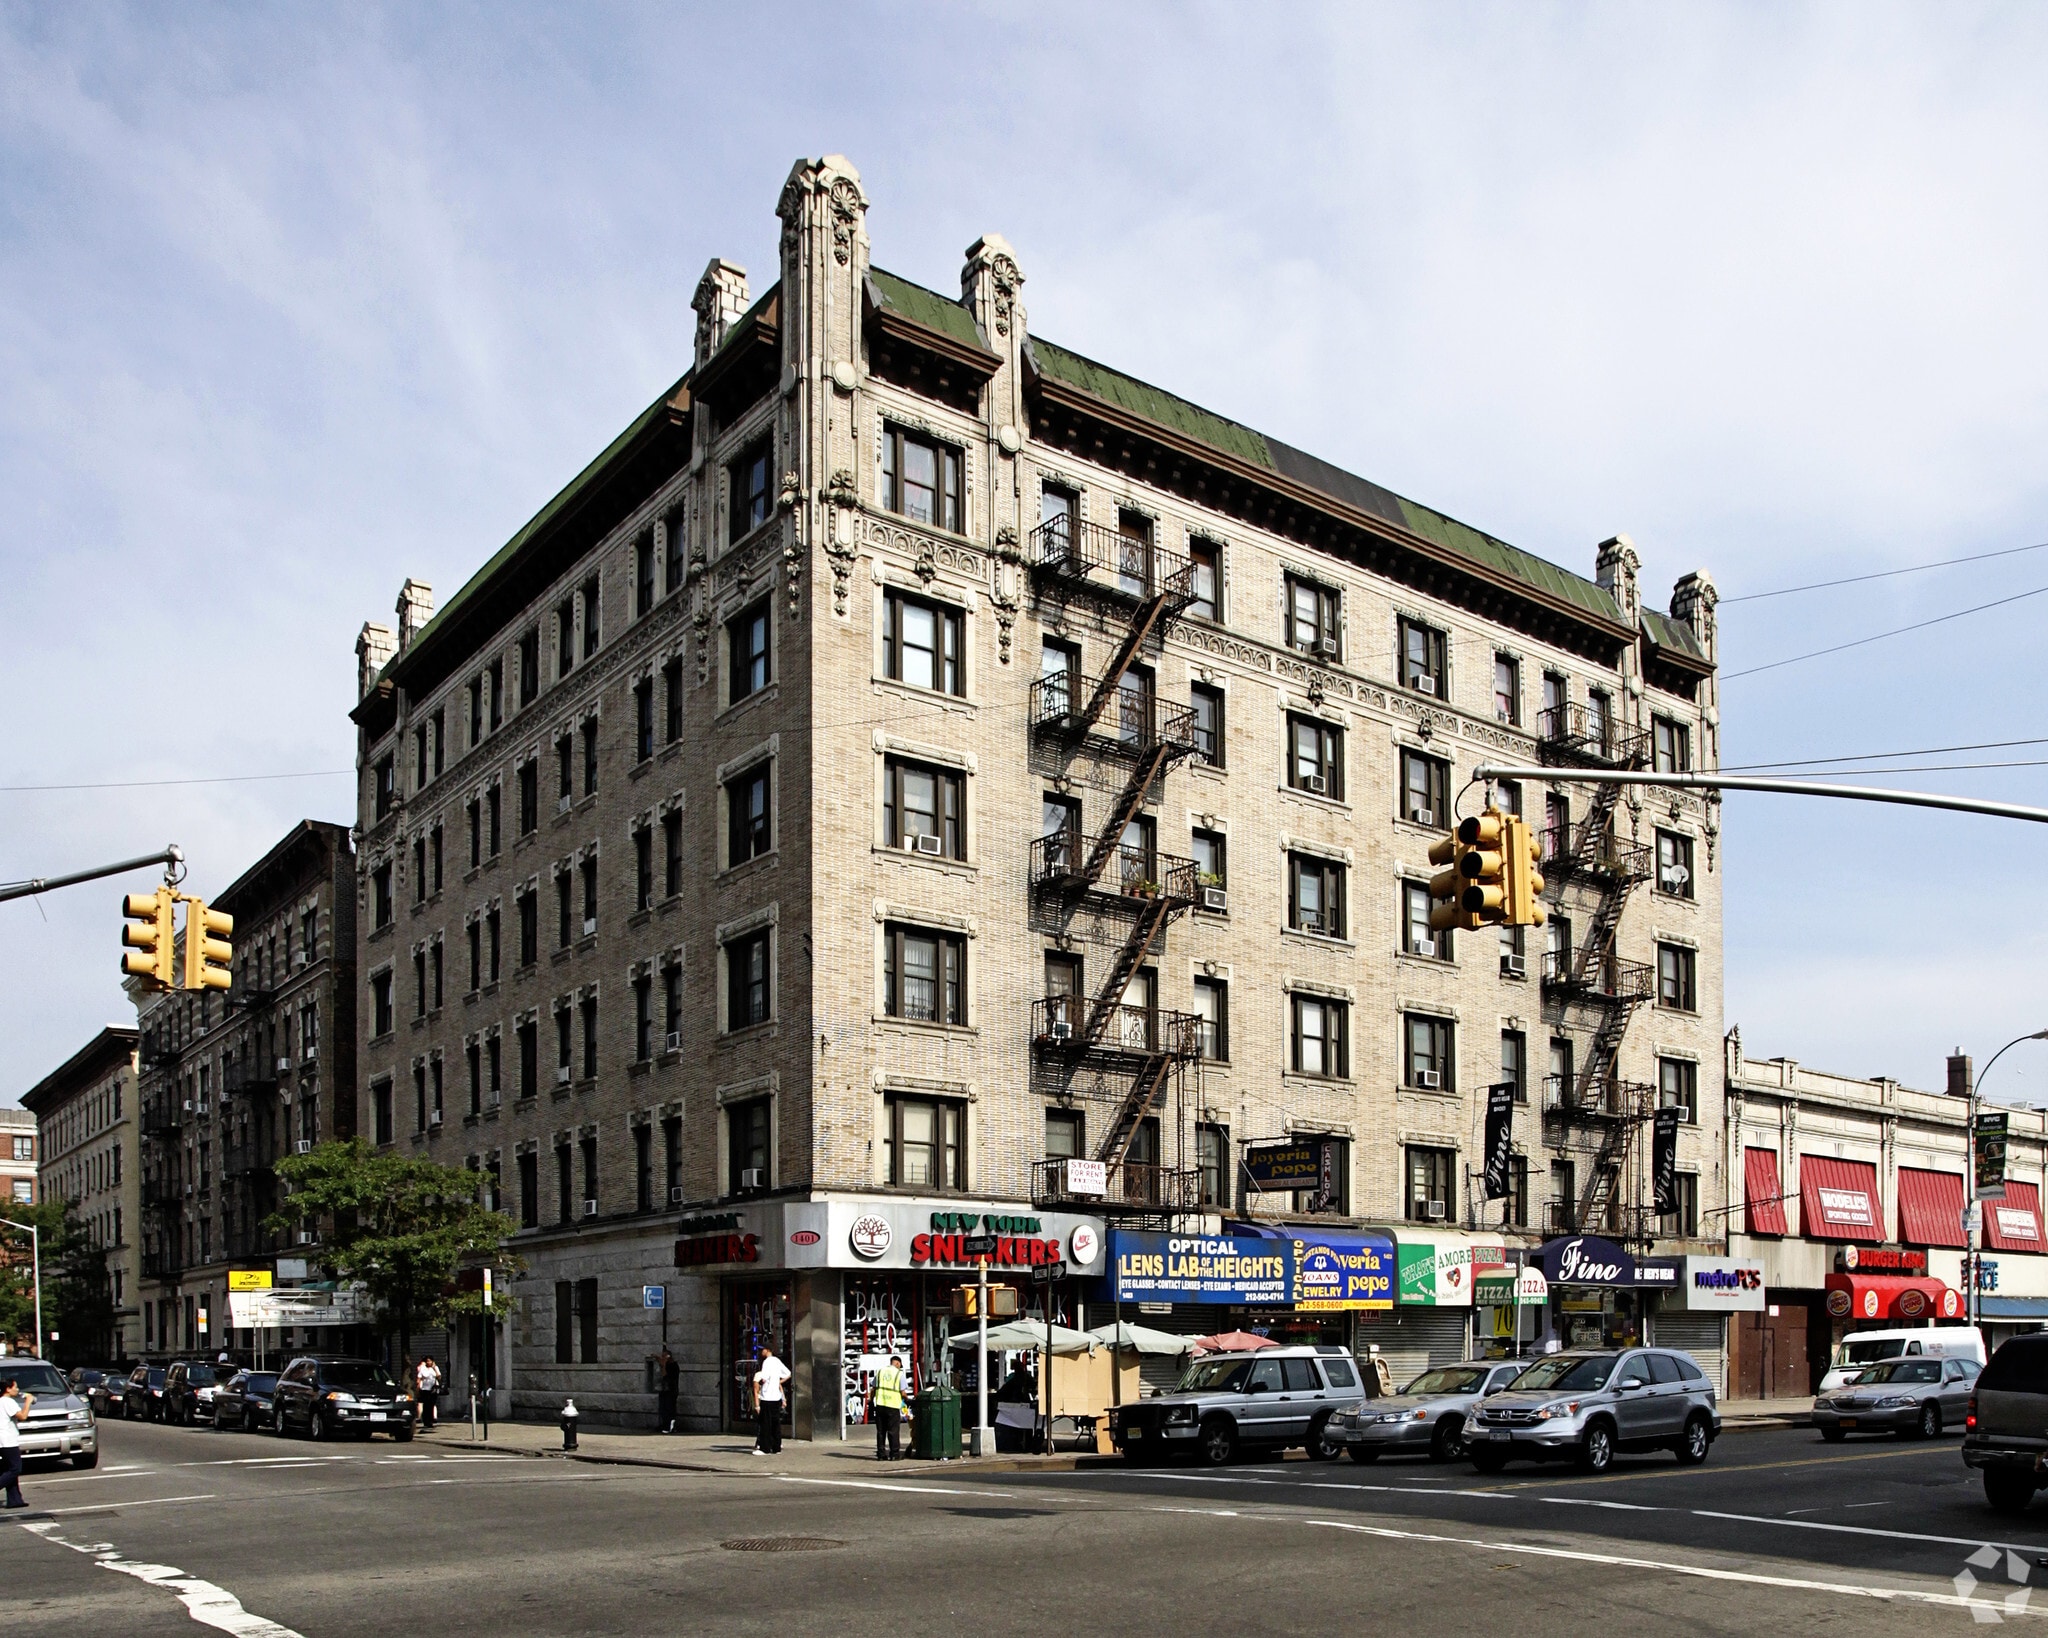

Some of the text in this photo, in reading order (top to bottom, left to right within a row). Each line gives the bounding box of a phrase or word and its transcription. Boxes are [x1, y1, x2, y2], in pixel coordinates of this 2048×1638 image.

[1071, 1161, 1102, 1170] STORE
[1485, 1120, 1509, 1194] Fino
[1271, 1164, 1317, 1177] pepe
[1822, 1193, 1867, 1210] MODELL'S
[931, 1212, 1042, 1233] NEW YORK
[1169, 1239, 1238, 1255] OPTICAL
[1121, 1254, 1200, 1278] LENS LAB
[1201, 1257, 1211, 1267] OF
[1213, 1257, 1284, 1279] HEIGHTS
[1438, 1249, 1472, 1269] AMORE
[1474, 1248, 1503, 1263] PIZZA
[1558, 1238, 1623, 1281] Fino
[1860, 1250, 1926, 1269] BURGER KING
[1200, 1267, 1213, 1278] THE
[1292, 1240, 1304, 1300] OPTICAL
[1696, 1269, 1760, 1289] metroPCS
[1121, 1279, 1132, 1288] EYE
[1303, 1286, 1342, 1297] EWELRY
[1348, 1275, 1390, 1298] pepe
[1476, 1286, 1512, 1299] PIZZA
[852, 1291, 903, 1323] BACK
[1360, 1310, 1380, 1318] ATM
[872, 1322, 897, 1350] TO
